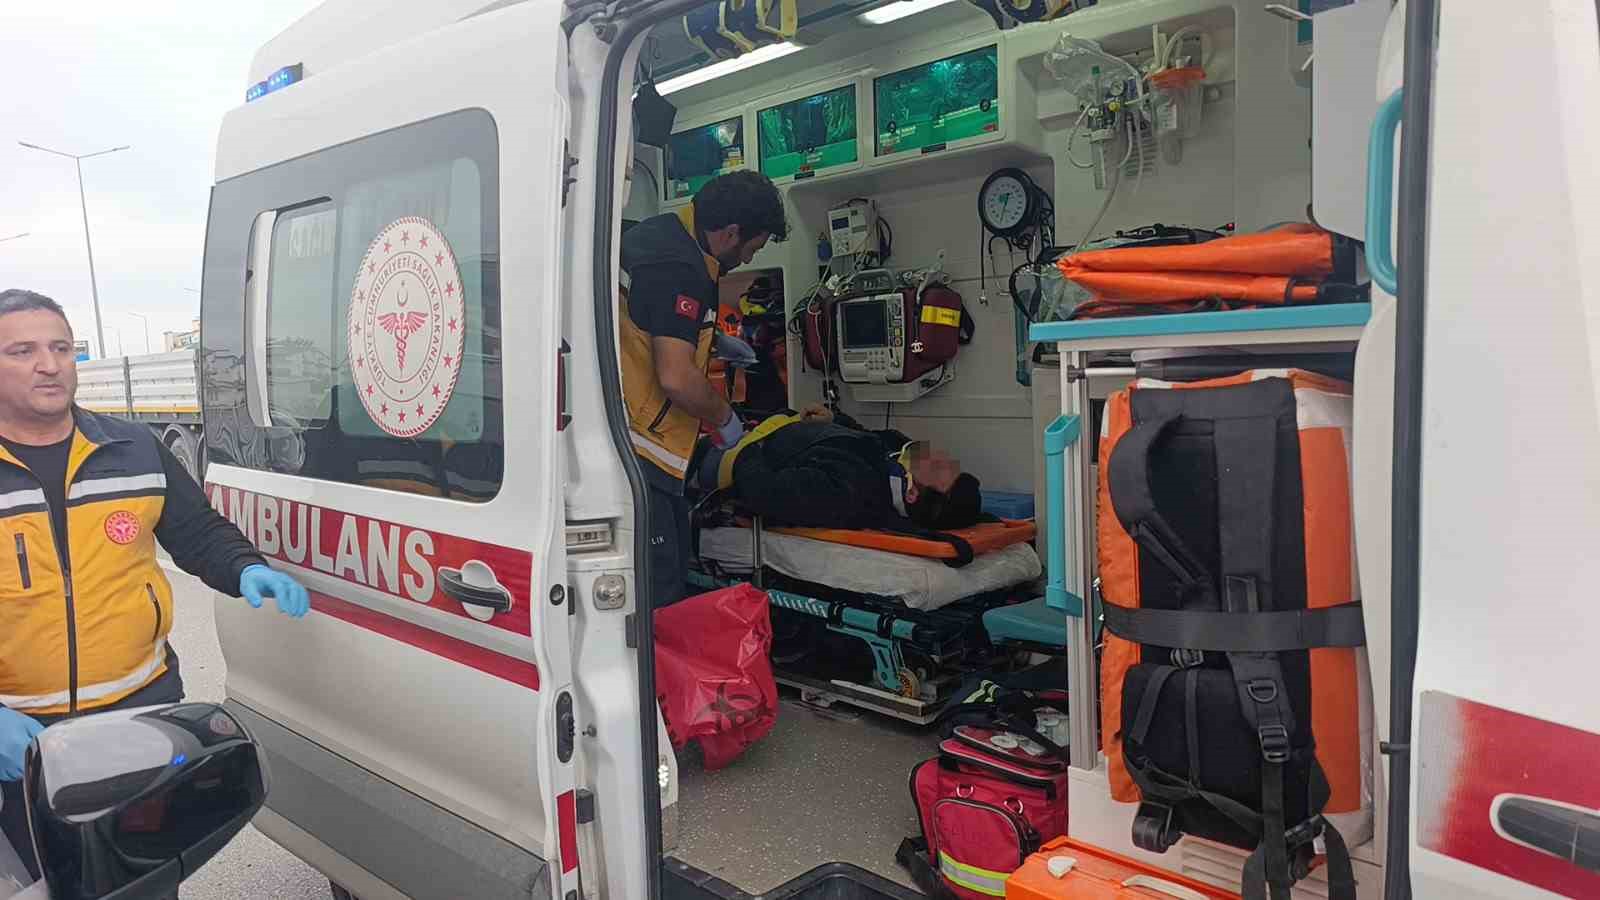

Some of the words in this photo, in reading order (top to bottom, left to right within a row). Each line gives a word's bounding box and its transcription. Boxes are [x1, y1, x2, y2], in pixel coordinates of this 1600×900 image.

[413, 259, 438, 298] SAĞLIK
[419, 302, 441, 385] BAKANLIĞI
[211, 485, 435, 603] AMBULANS
